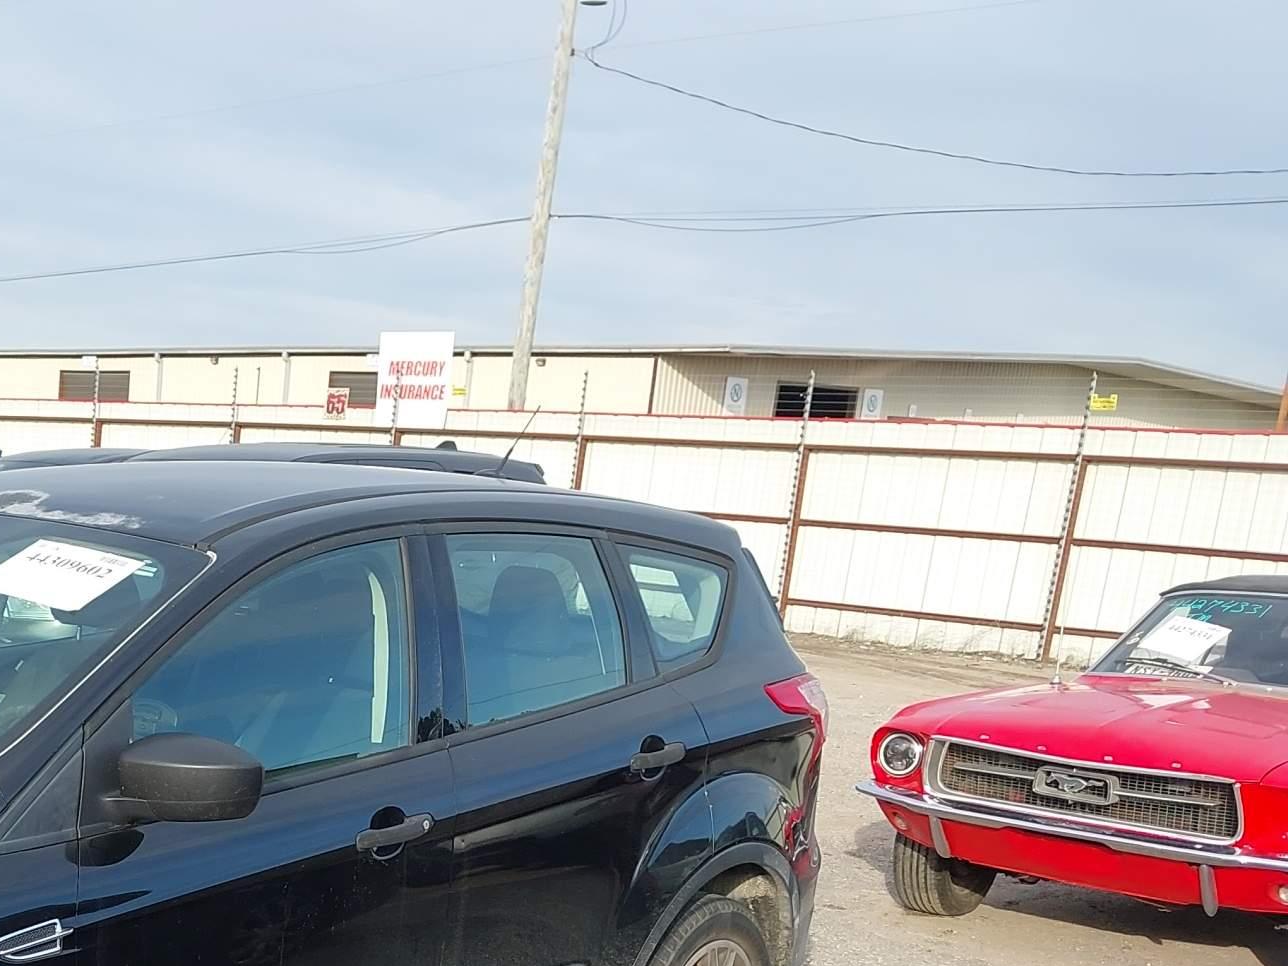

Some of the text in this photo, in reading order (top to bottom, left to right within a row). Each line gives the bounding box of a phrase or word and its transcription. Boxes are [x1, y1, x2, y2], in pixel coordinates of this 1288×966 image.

[388, 360, 446, 377] MERCURY
[379, 383, 447, 401] INSURANCE
[26, 552, 113, 579] 44309602
